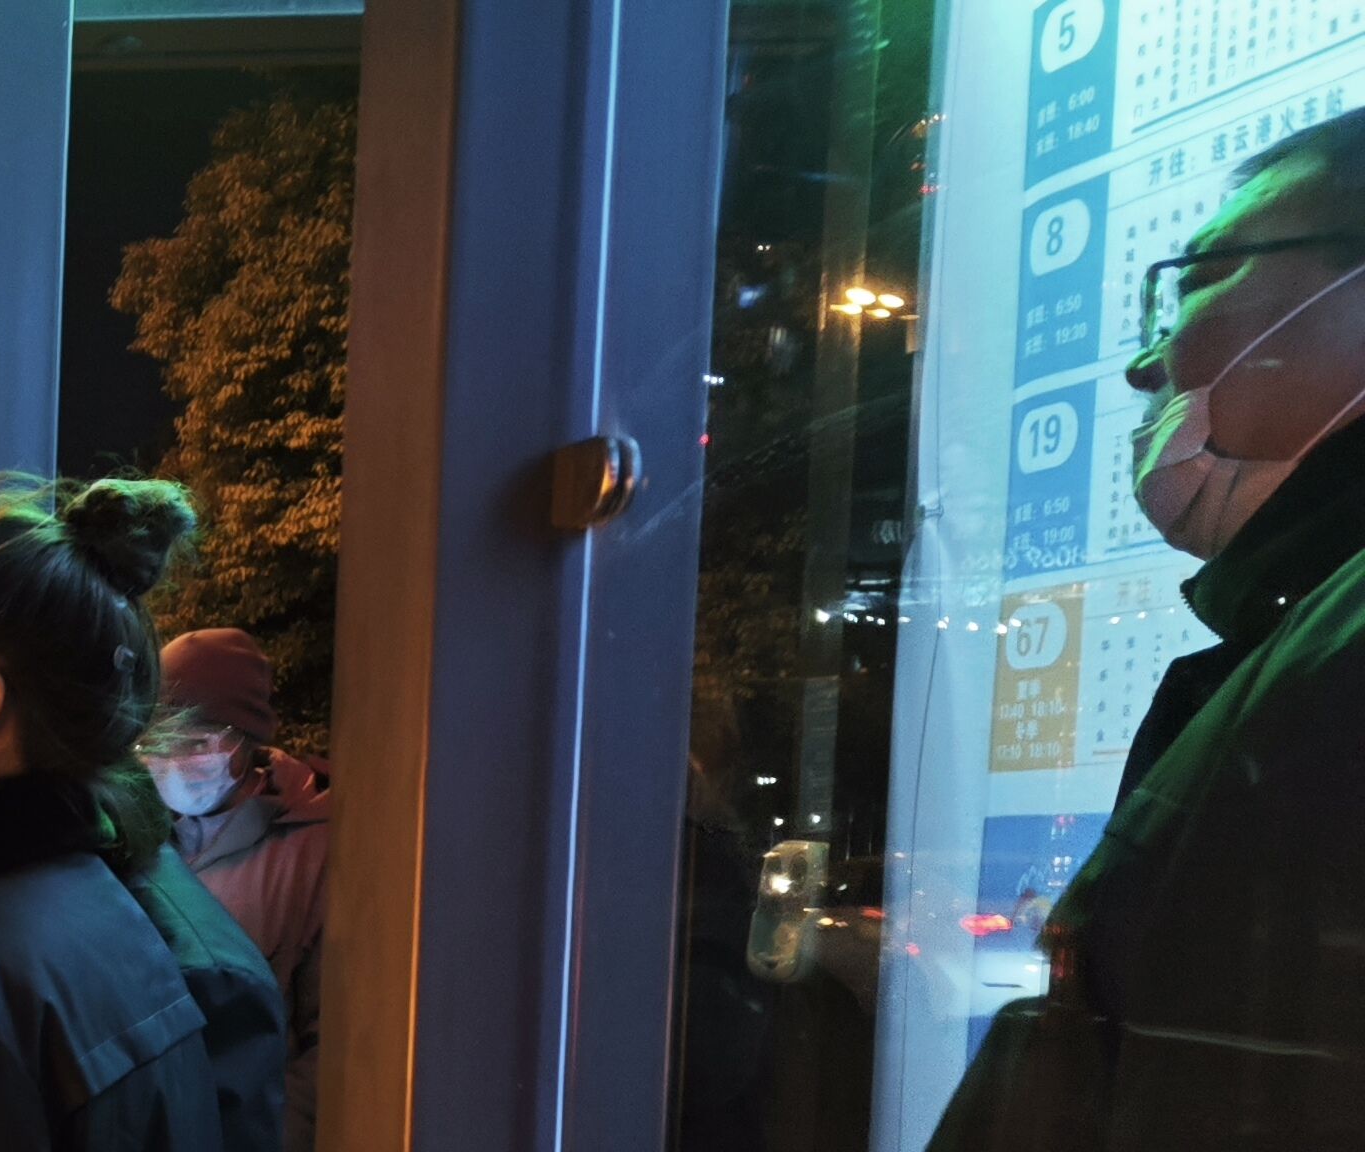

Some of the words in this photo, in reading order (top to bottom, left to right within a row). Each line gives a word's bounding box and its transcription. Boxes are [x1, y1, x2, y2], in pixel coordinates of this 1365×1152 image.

[1058, 10, 1076, 53] 5
[1046, 215, 1064, 256] 8
[1030, 414, 1061, 459] 19
[1016, 616, 1049, 657] 67
